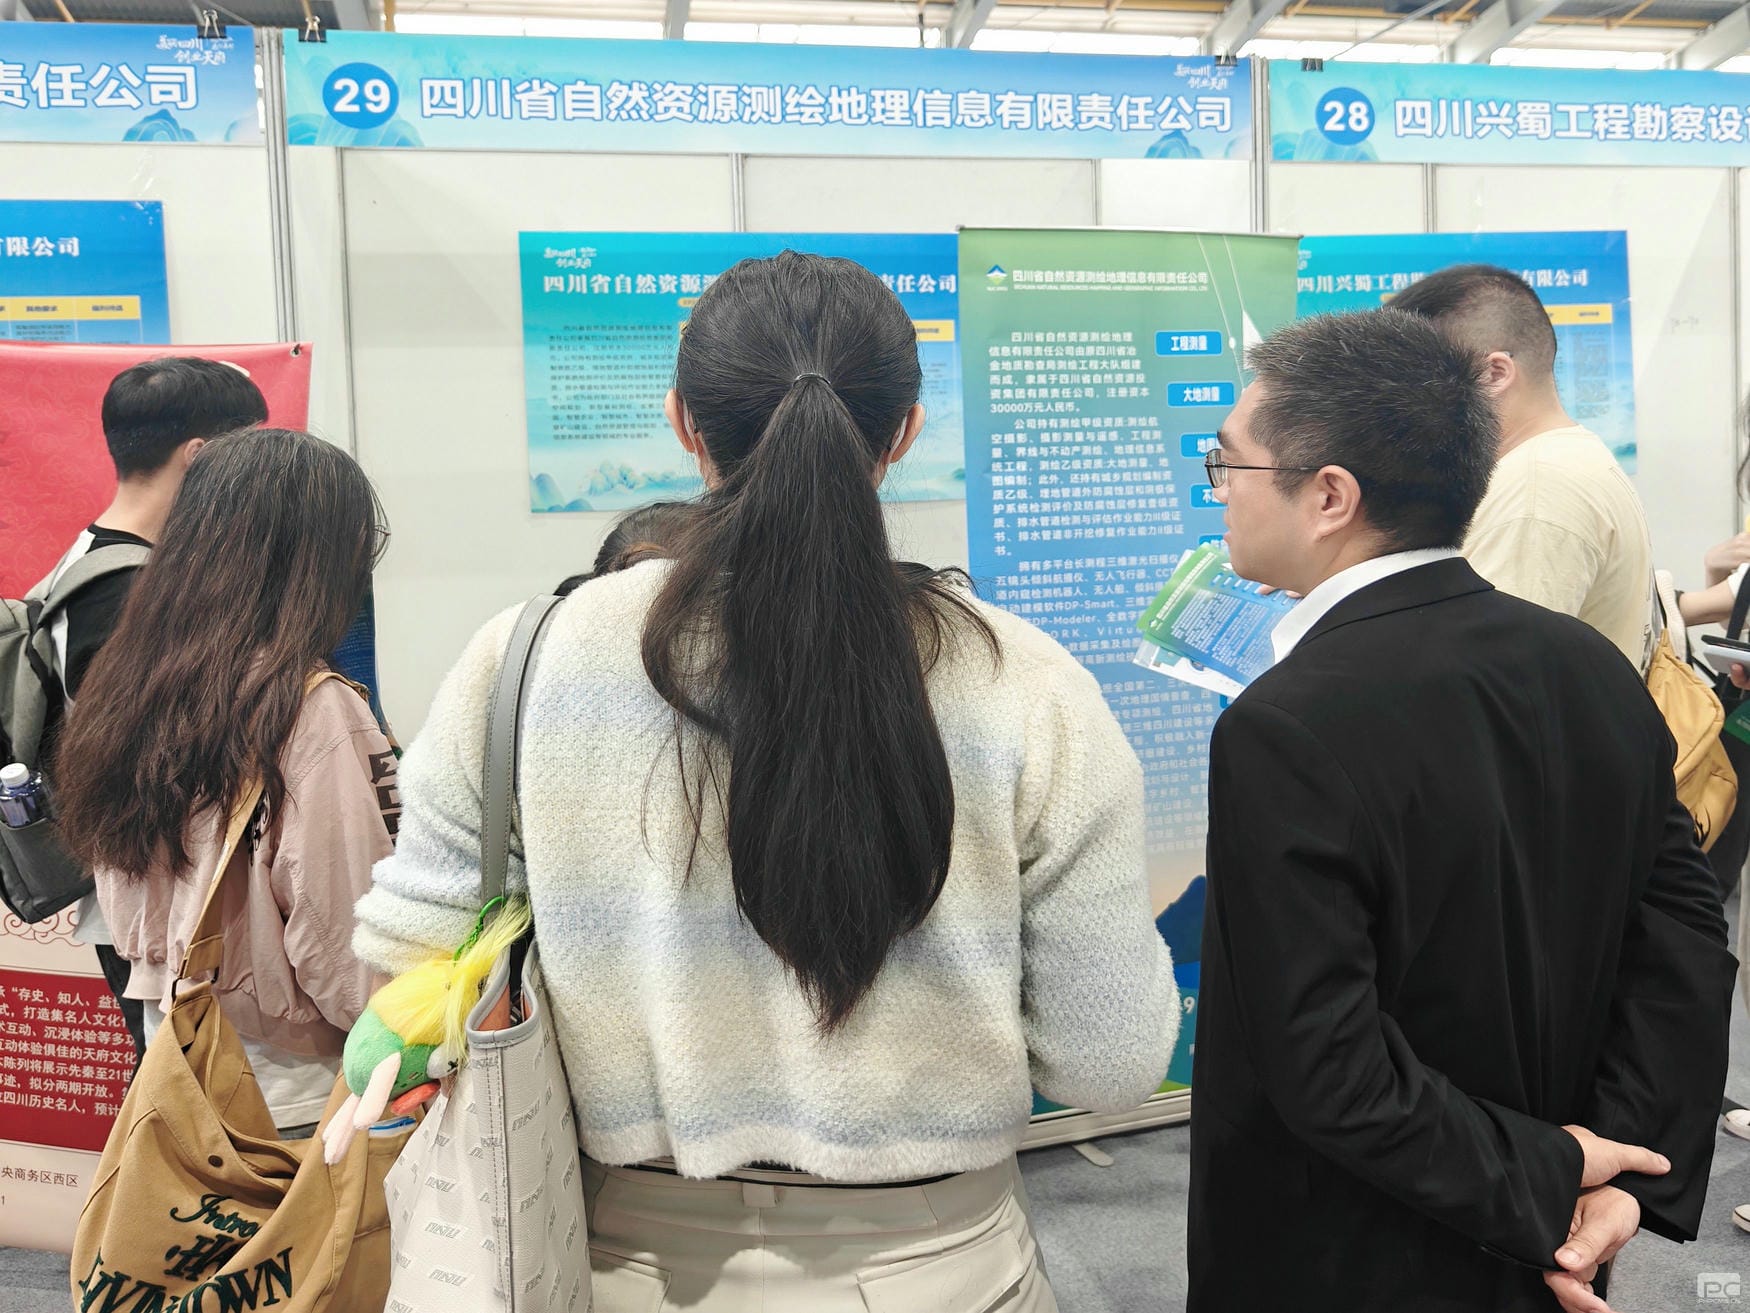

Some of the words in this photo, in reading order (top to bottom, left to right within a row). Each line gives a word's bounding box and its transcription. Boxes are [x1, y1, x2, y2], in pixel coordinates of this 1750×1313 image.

[332, 77, 392, 114] 29
[420, 77, 1233, 134] 四川省自然资源测绘地理信息有限责任公司
[1322, 103, 1369, 132] 28
[0, 236, 80, 257] 限公司
[1170, 335, 1209, 352] 工程测量
[1183, 386, 1221, 403] 大地测量
[2, 1165, 79, 1188] 央商务区西区
[170, 1193, 262, 1239] Intro
